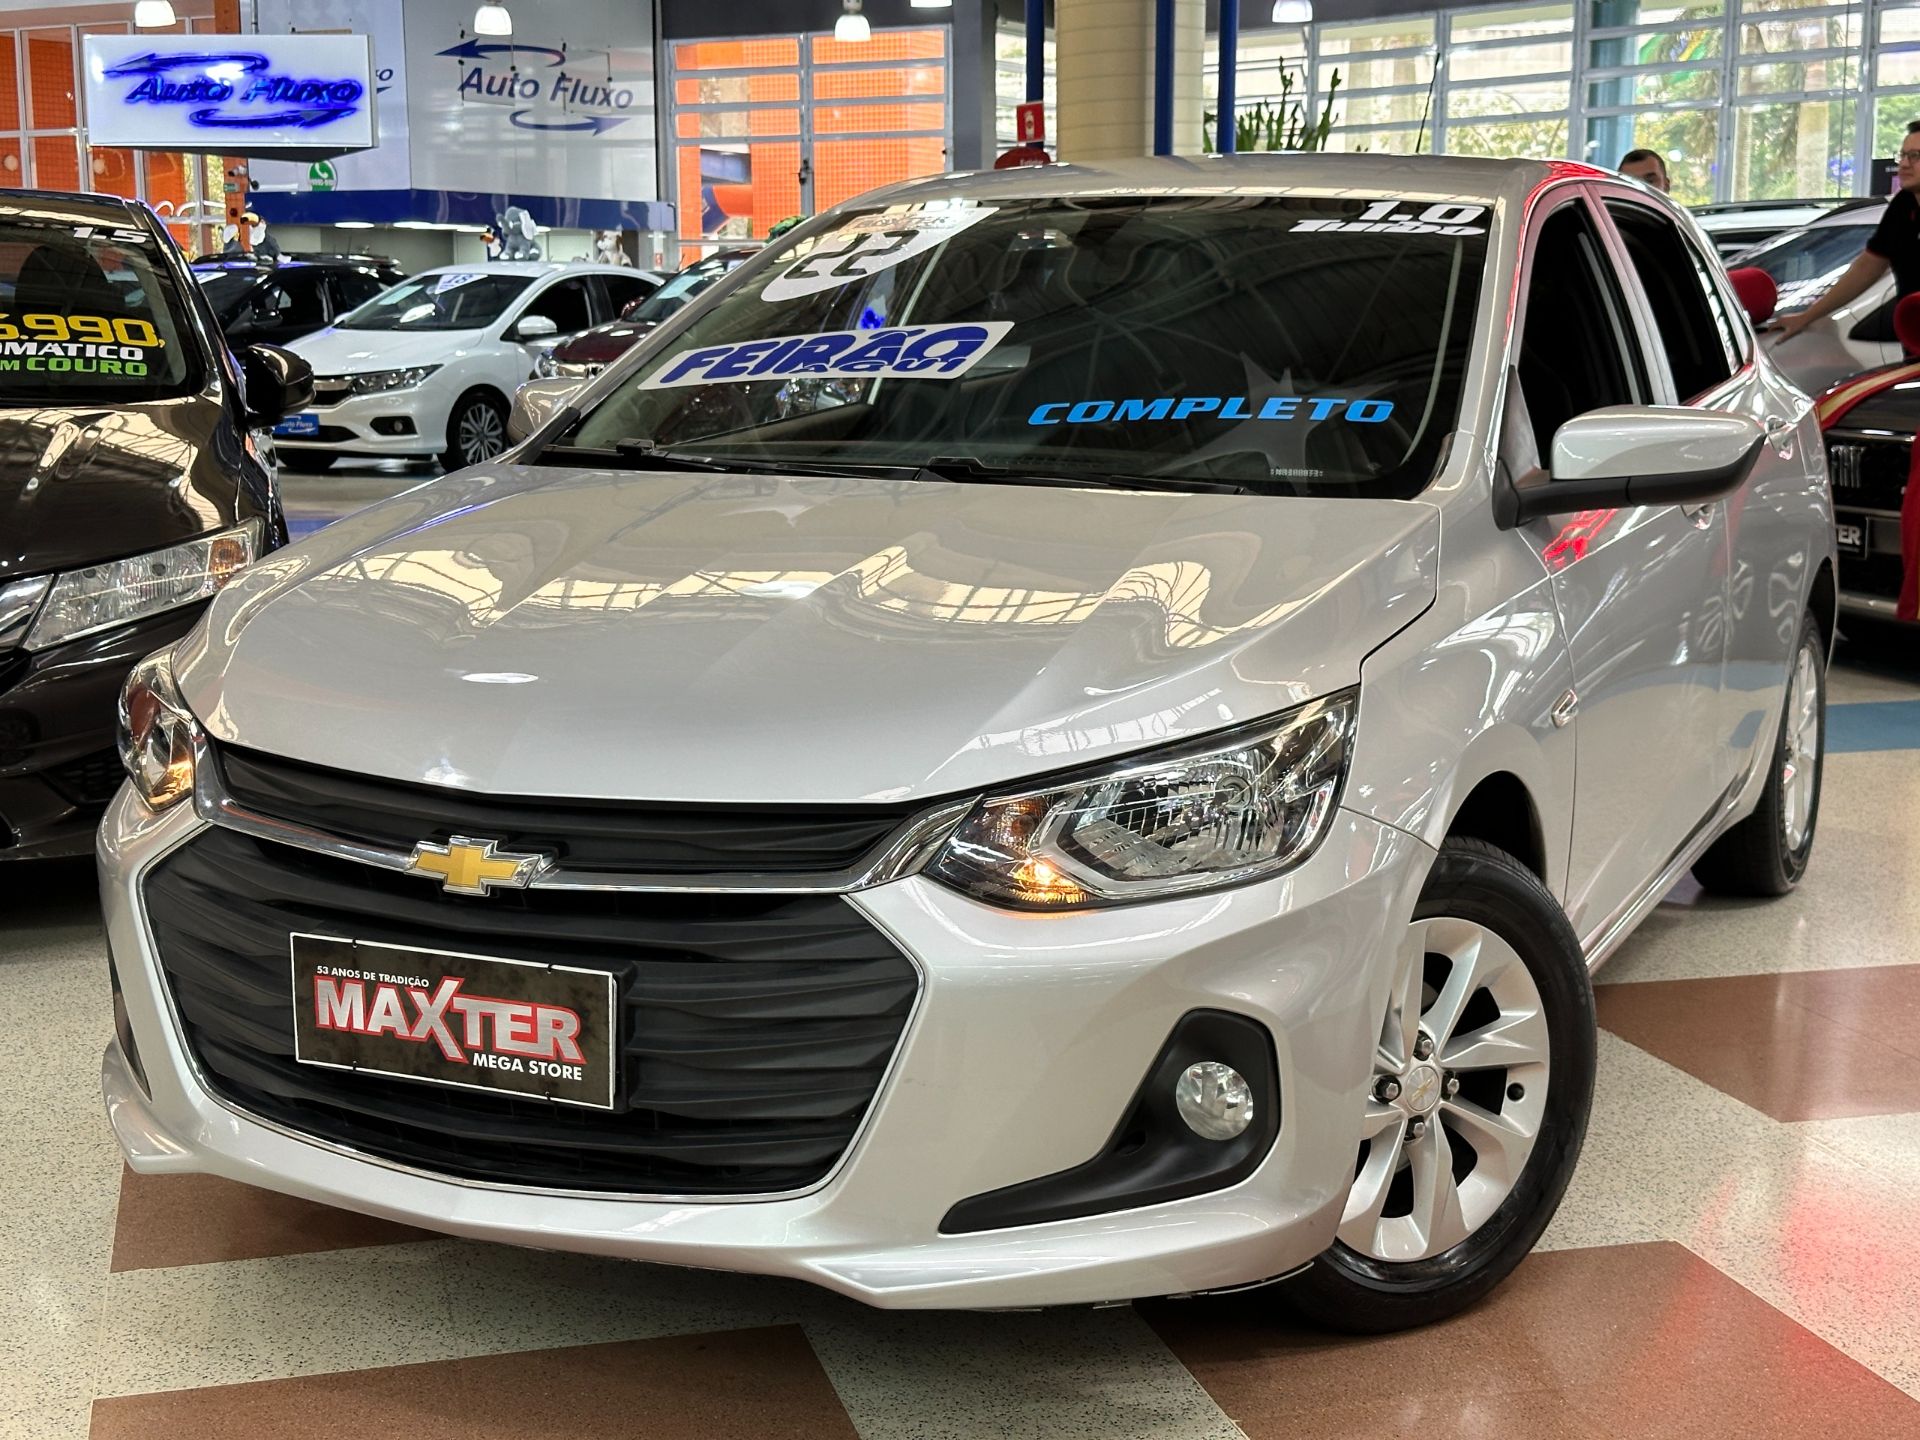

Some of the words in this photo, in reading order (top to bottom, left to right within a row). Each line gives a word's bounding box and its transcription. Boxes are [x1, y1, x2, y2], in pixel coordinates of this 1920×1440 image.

[125, 76, 233, 102] Auto
[240, 77, 362, 104] Fluxo
[456, 67, 540, 99] Auto
[550, 75, 634, 109] Fluxo
[1358, 201, 1486, 224] 1.0
[73, 226, 149, 244] 1.5
[784, 230, 920, 280] 22
[0, 341, 144, 361] MATICO
[660, 326, 989, 384] FEIRÃO
[26, 357, 148, 376] COURO
[1027, 396, 1395, 425] COMPLETO
[316, 965, 329, 975] 53
[331, 967, 361, 980] ANOS
[363, 971, 376, 981] DE
[378, 973, 430, 988] TRADIÇÃO
[313, 975, 588, 1064] MAXTER
[472, 1052, 524, 1073] MEGA
[529, 1060, 582, 1081] STORE
